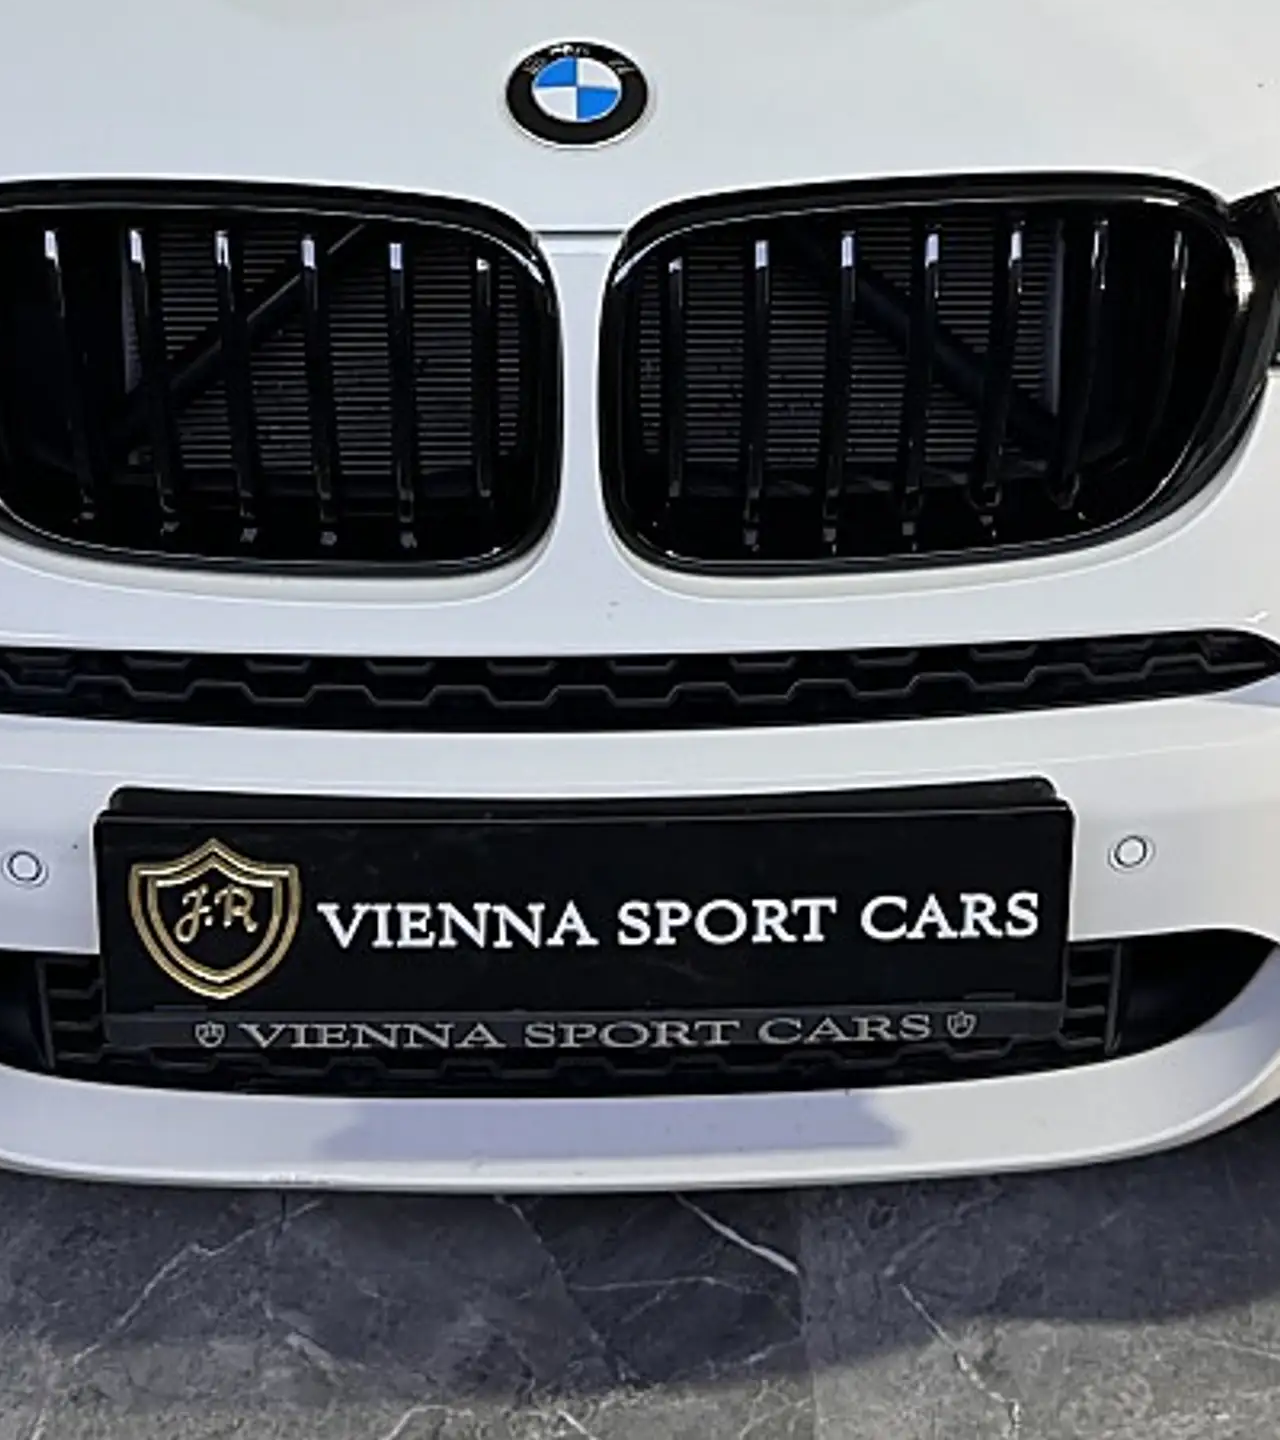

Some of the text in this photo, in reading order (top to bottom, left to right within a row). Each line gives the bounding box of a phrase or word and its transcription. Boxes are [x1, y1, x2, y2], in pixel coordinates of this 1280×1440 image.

[317, 891, 1039, 949] VIENNA SPORT CARS
[238, 1021, 507, 1050] VIENNA
[523, 1020, 741, 1049] SPORT
[757, 1014, 933, 1045] CARS
